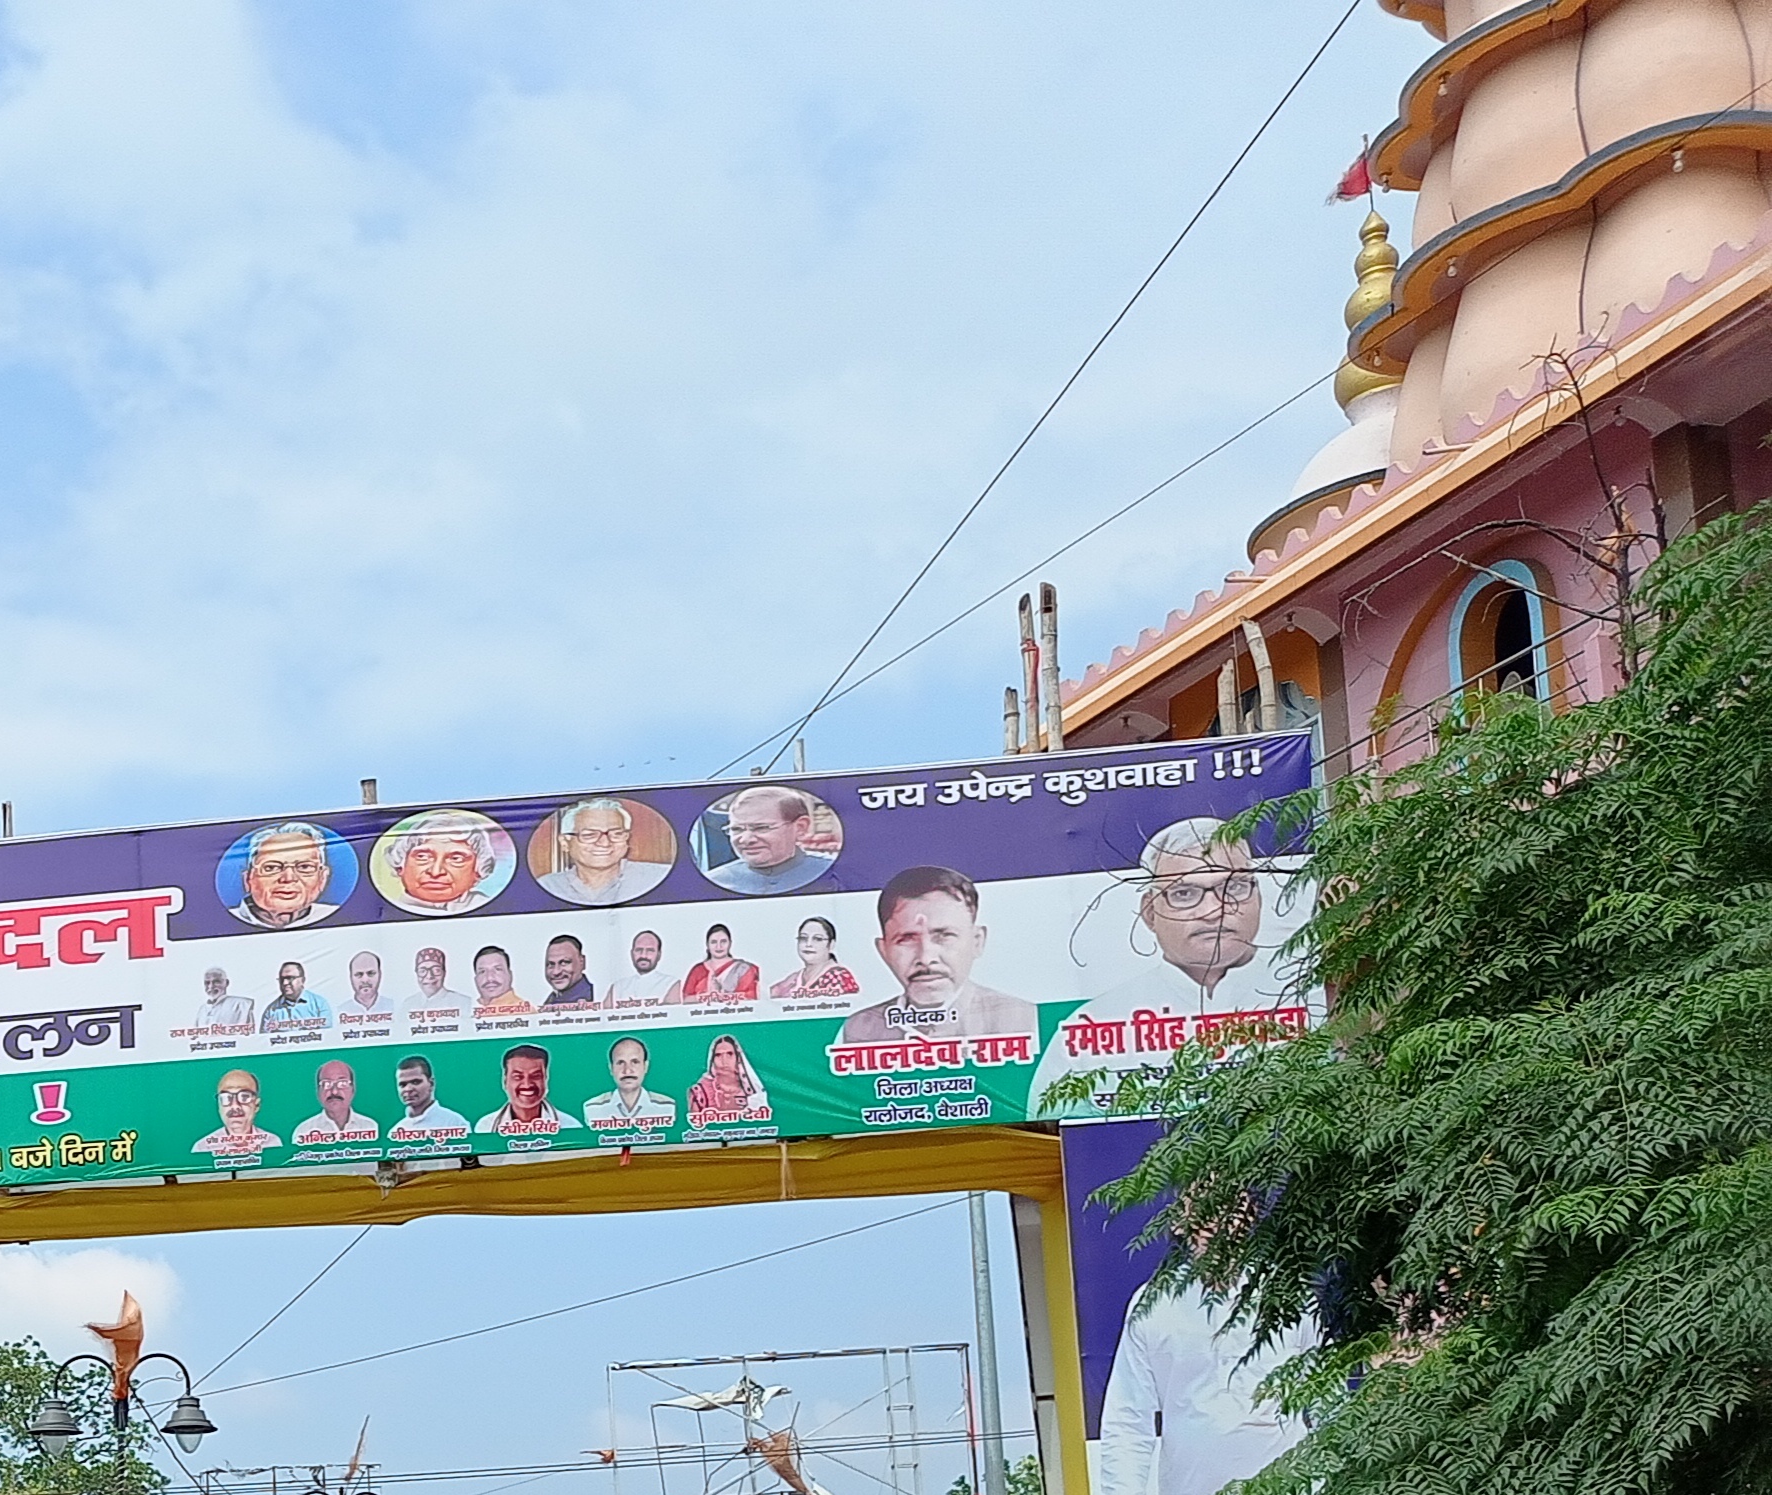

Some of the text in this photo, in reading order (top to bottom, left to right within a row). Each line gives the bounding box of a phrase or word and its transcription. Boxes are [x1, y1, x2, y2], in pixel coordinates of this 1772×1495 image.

[859, 747, 1263, 810] जय उपेन्द्र कुशवाहा !!!
[887, 1006, 944, 1028] निवेदक
[187, 1026, 210, 1041] कुमार
[1062, 1006, 1186, 1058] रमेश सिंह
[834, 1035, 1031, 1073] लालदेव राम
[876, 1074, 977, 1100] जिला अध्यक्ष
[34, 1083, 69, 1125] !
[863, 1095, 990, 1127] रालोजद, वैशाली
[531, 1118, 558, 1134] सिंह
[591, 1115, 672, 1133] मनोज कुमार
[690, 1105, 770, 1128] सुनिता देवी
[297, 1129, 377, 1145] अनिल भगता
[391, 1126, 467, 1145] नीरज कुमार
[6, 1143, 54, 1168] बजे
[57, 1139, 107, 1164] दिन
[110, 1131, 140, 1163] में
